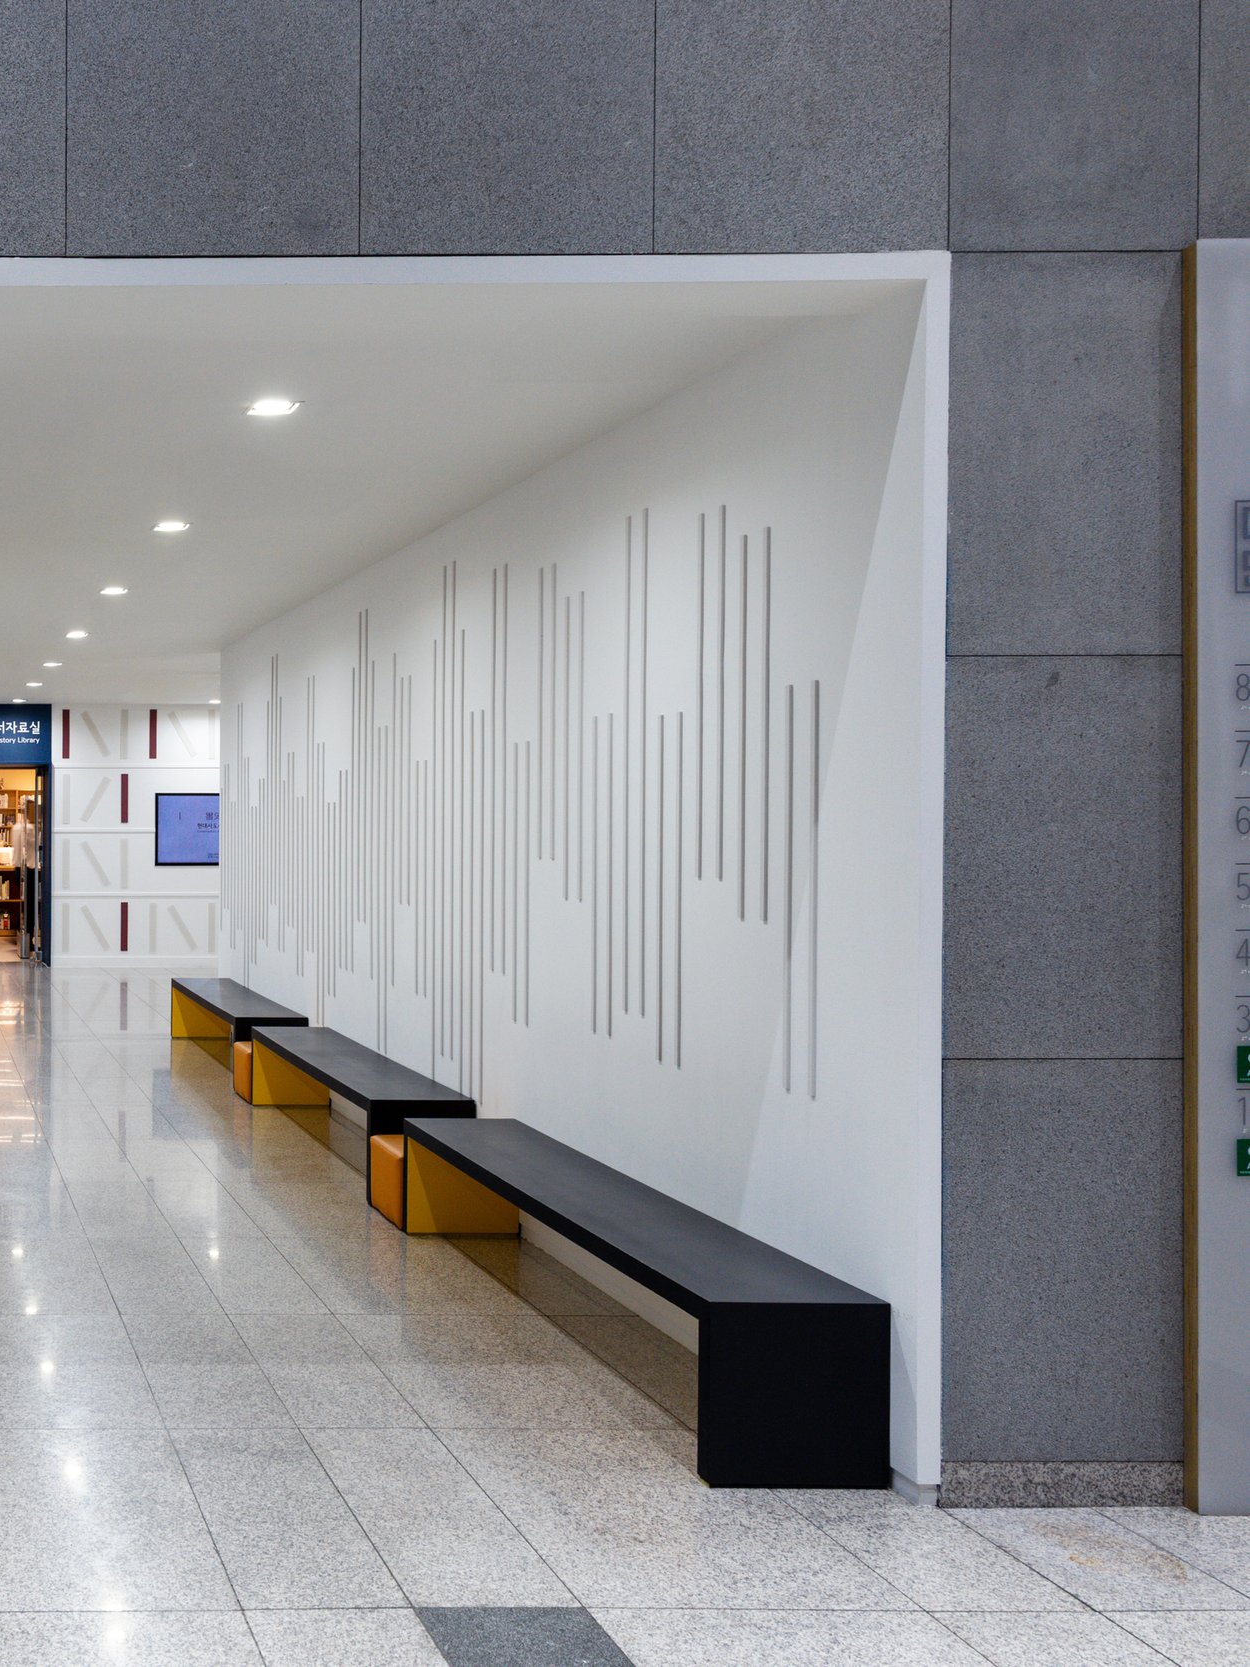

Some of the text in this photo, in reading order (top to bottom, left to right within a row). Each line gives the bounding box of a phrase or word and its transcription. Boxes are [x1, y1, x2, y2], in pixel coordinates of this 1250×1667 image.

[1236, 673, 1250, 701] 8
[17, 737, 40, 745] Library
[1235, 740, 1250, 767] 7
[1236, 806, 1250, 835] 6
[1236, 872, 1250, 900] 5
[1236, 1004, 1250, 1033] 3
